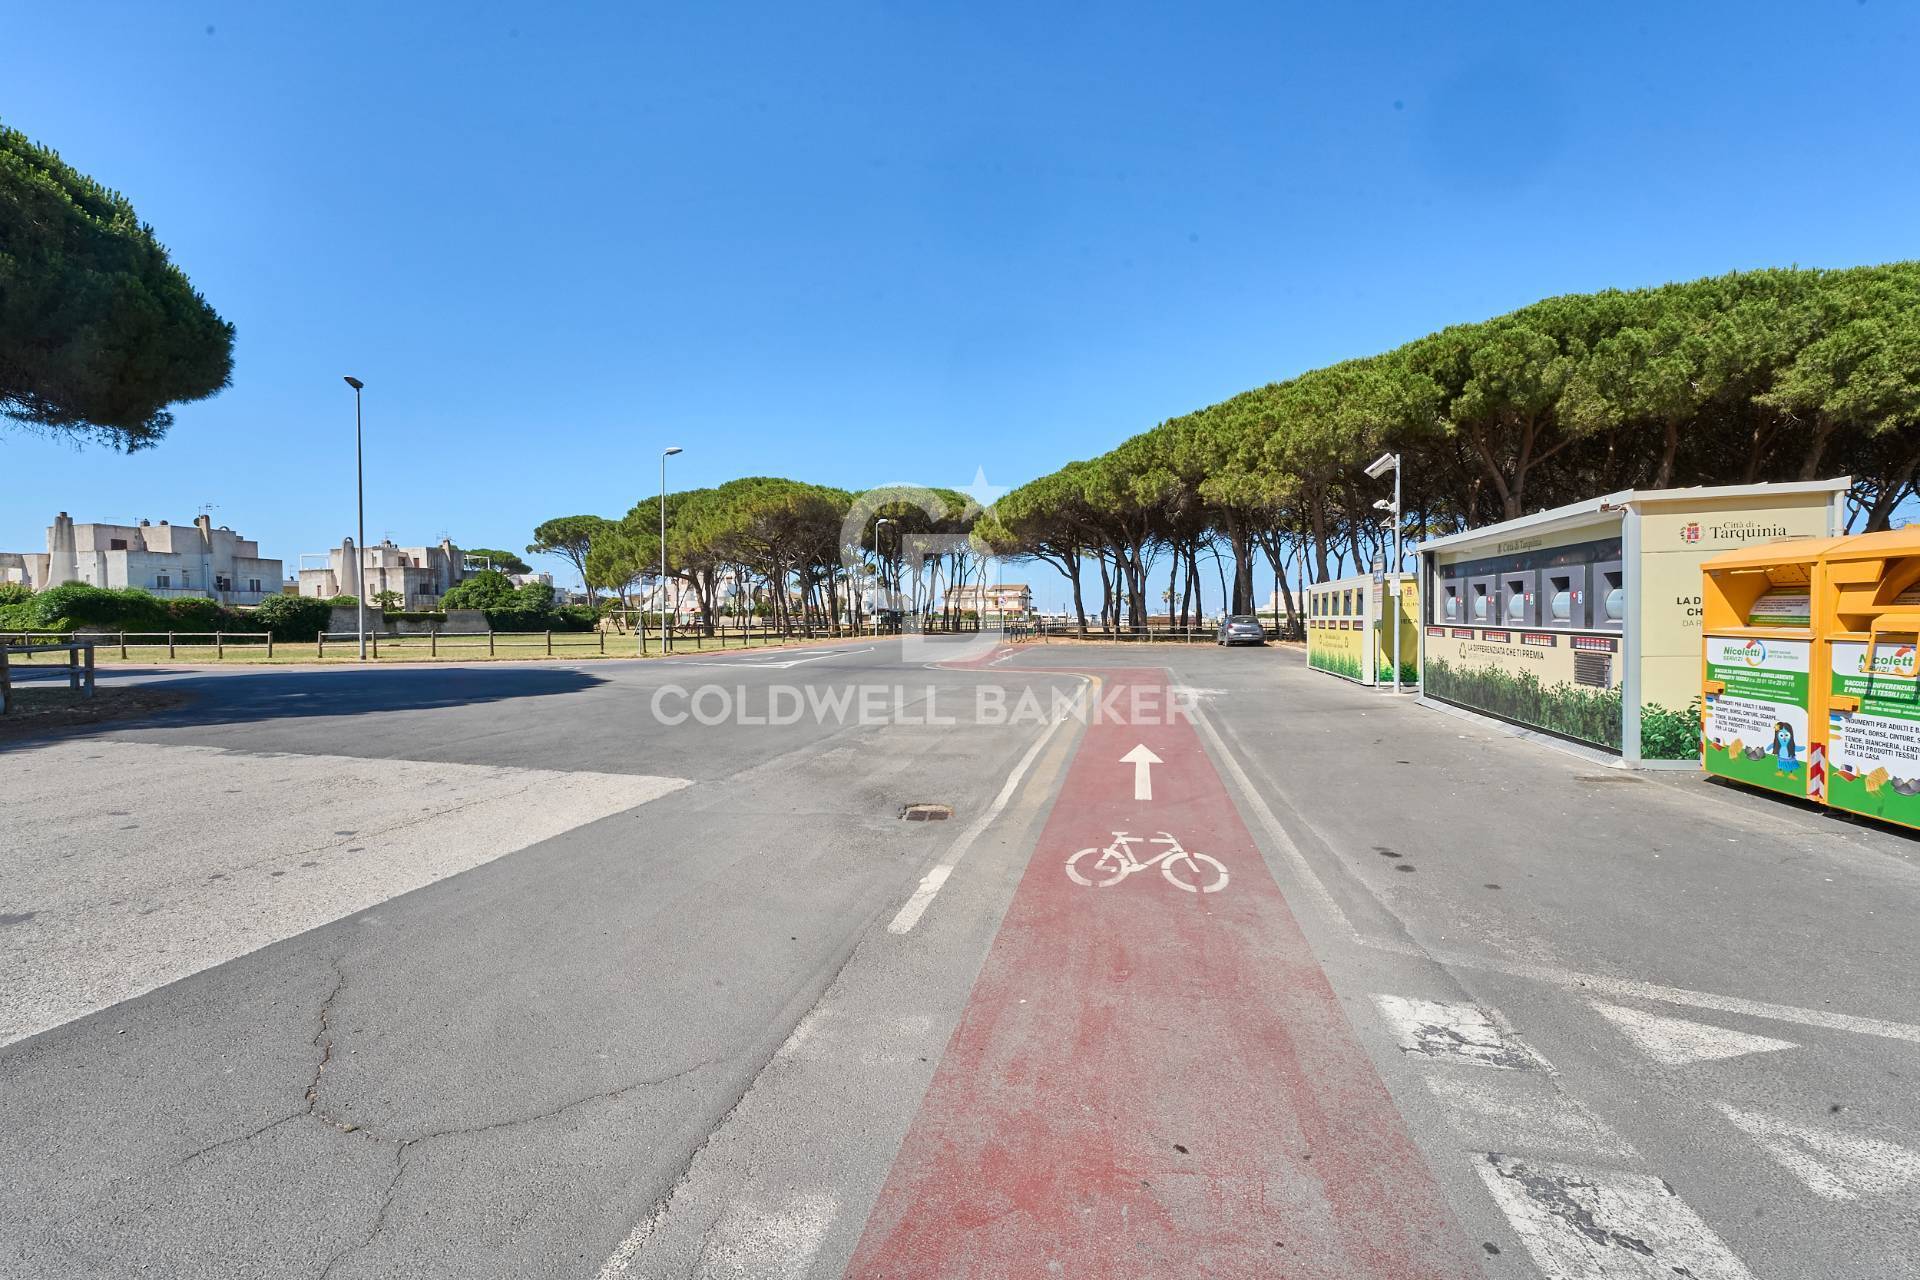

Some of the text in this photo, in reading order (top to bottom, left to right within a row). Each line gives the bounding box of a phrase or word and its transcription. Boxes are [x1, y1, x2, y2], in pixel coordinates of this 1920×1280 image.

[1723, 520, 1755, 529] Città di
[1709, 523, 1787, 541] Tarquinia
[1676, 596, 1691, 605] LA
[1467, 643, 1473, 651] LA
[1473, 644, 1506, 655] DIFFERENZIATA
[1506, 648, 1516, 657] CHE
[1522, 649, 1544, 660] PREMIA
[1723, 646, 1760, 657] Nicoletti
[1858, 653, 1914, 667] Ncolett
[1877, 690, 1900, 698] TESSILI
[1845, 718, 1875, 728] INDUMENTI
[1875, 721, 1887, 729] PER
[1888, 723, 1909, 732] ADULTI
[1844, 726, 1867, 735] SCARPE,
[1868, 730, 1888, 739] BORSE,
[1889, 733, 1916, 743] CINTURE,
[1845, 735, 1863, 744] TENDE,
[1865, 738, 1902, 750] BIANCHERIA,
[1844, 748, 1880, 761] PER LA CASA
[1849, 743, 1865, 751] ALTRI
[1866, 745, 1894, 757] PRODOTTI
[1895, 751, 1918, 761] TESSILI
